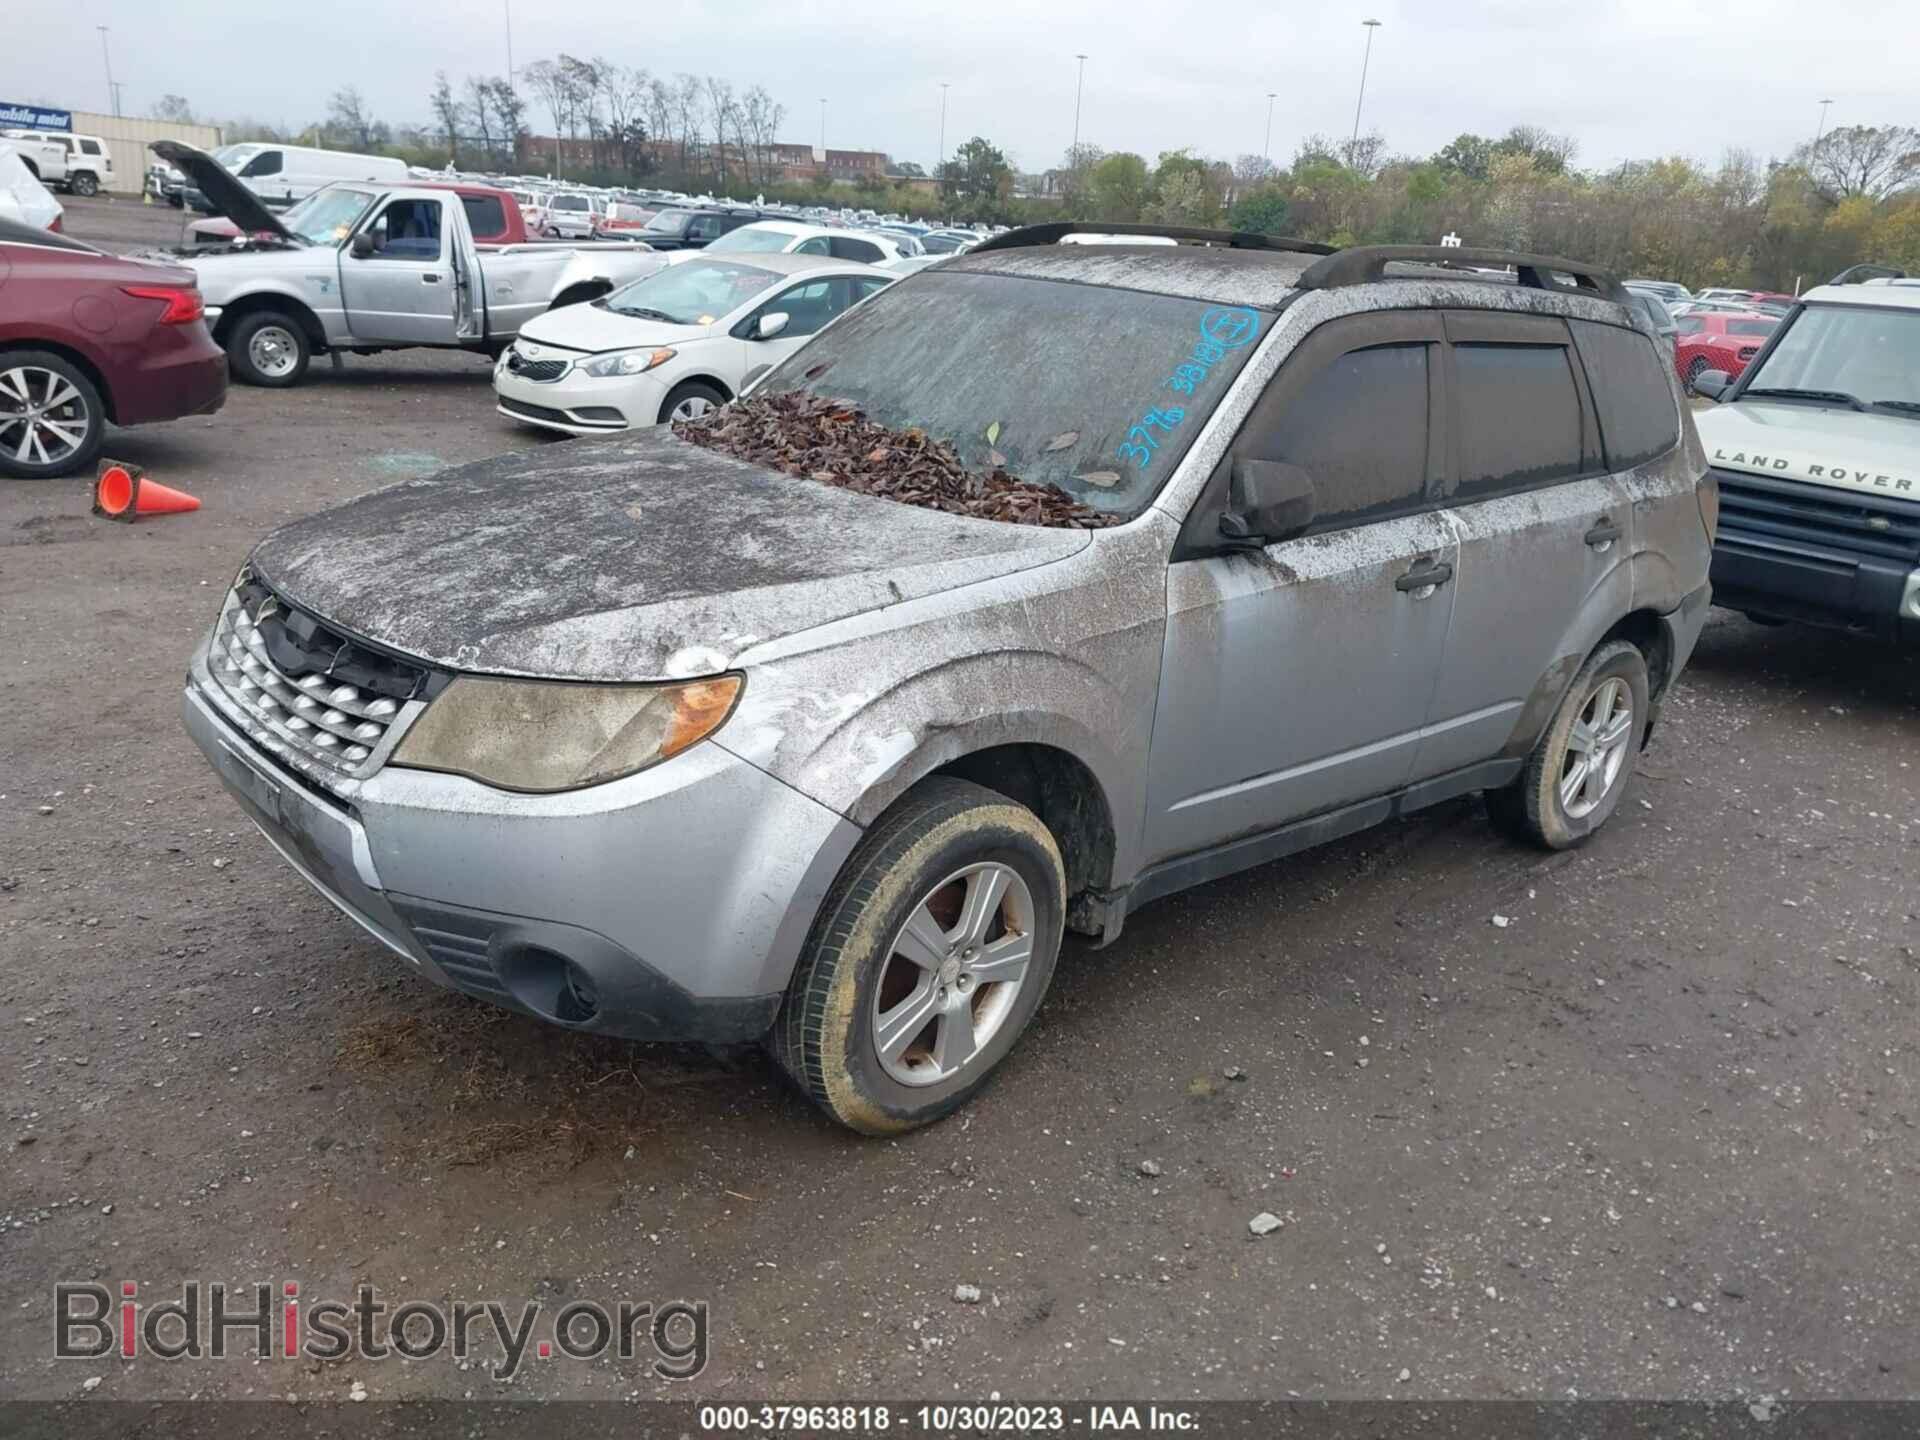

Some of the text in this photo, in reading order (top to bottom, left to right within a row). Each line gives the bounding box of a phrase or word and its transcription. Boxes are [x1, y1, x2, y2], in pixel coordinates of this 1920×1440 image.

[0, 106, 36, 123] obile
[1117, 406, 1184, 468] 3796
[1714, 449, 1913, 490] LAND ROVER
